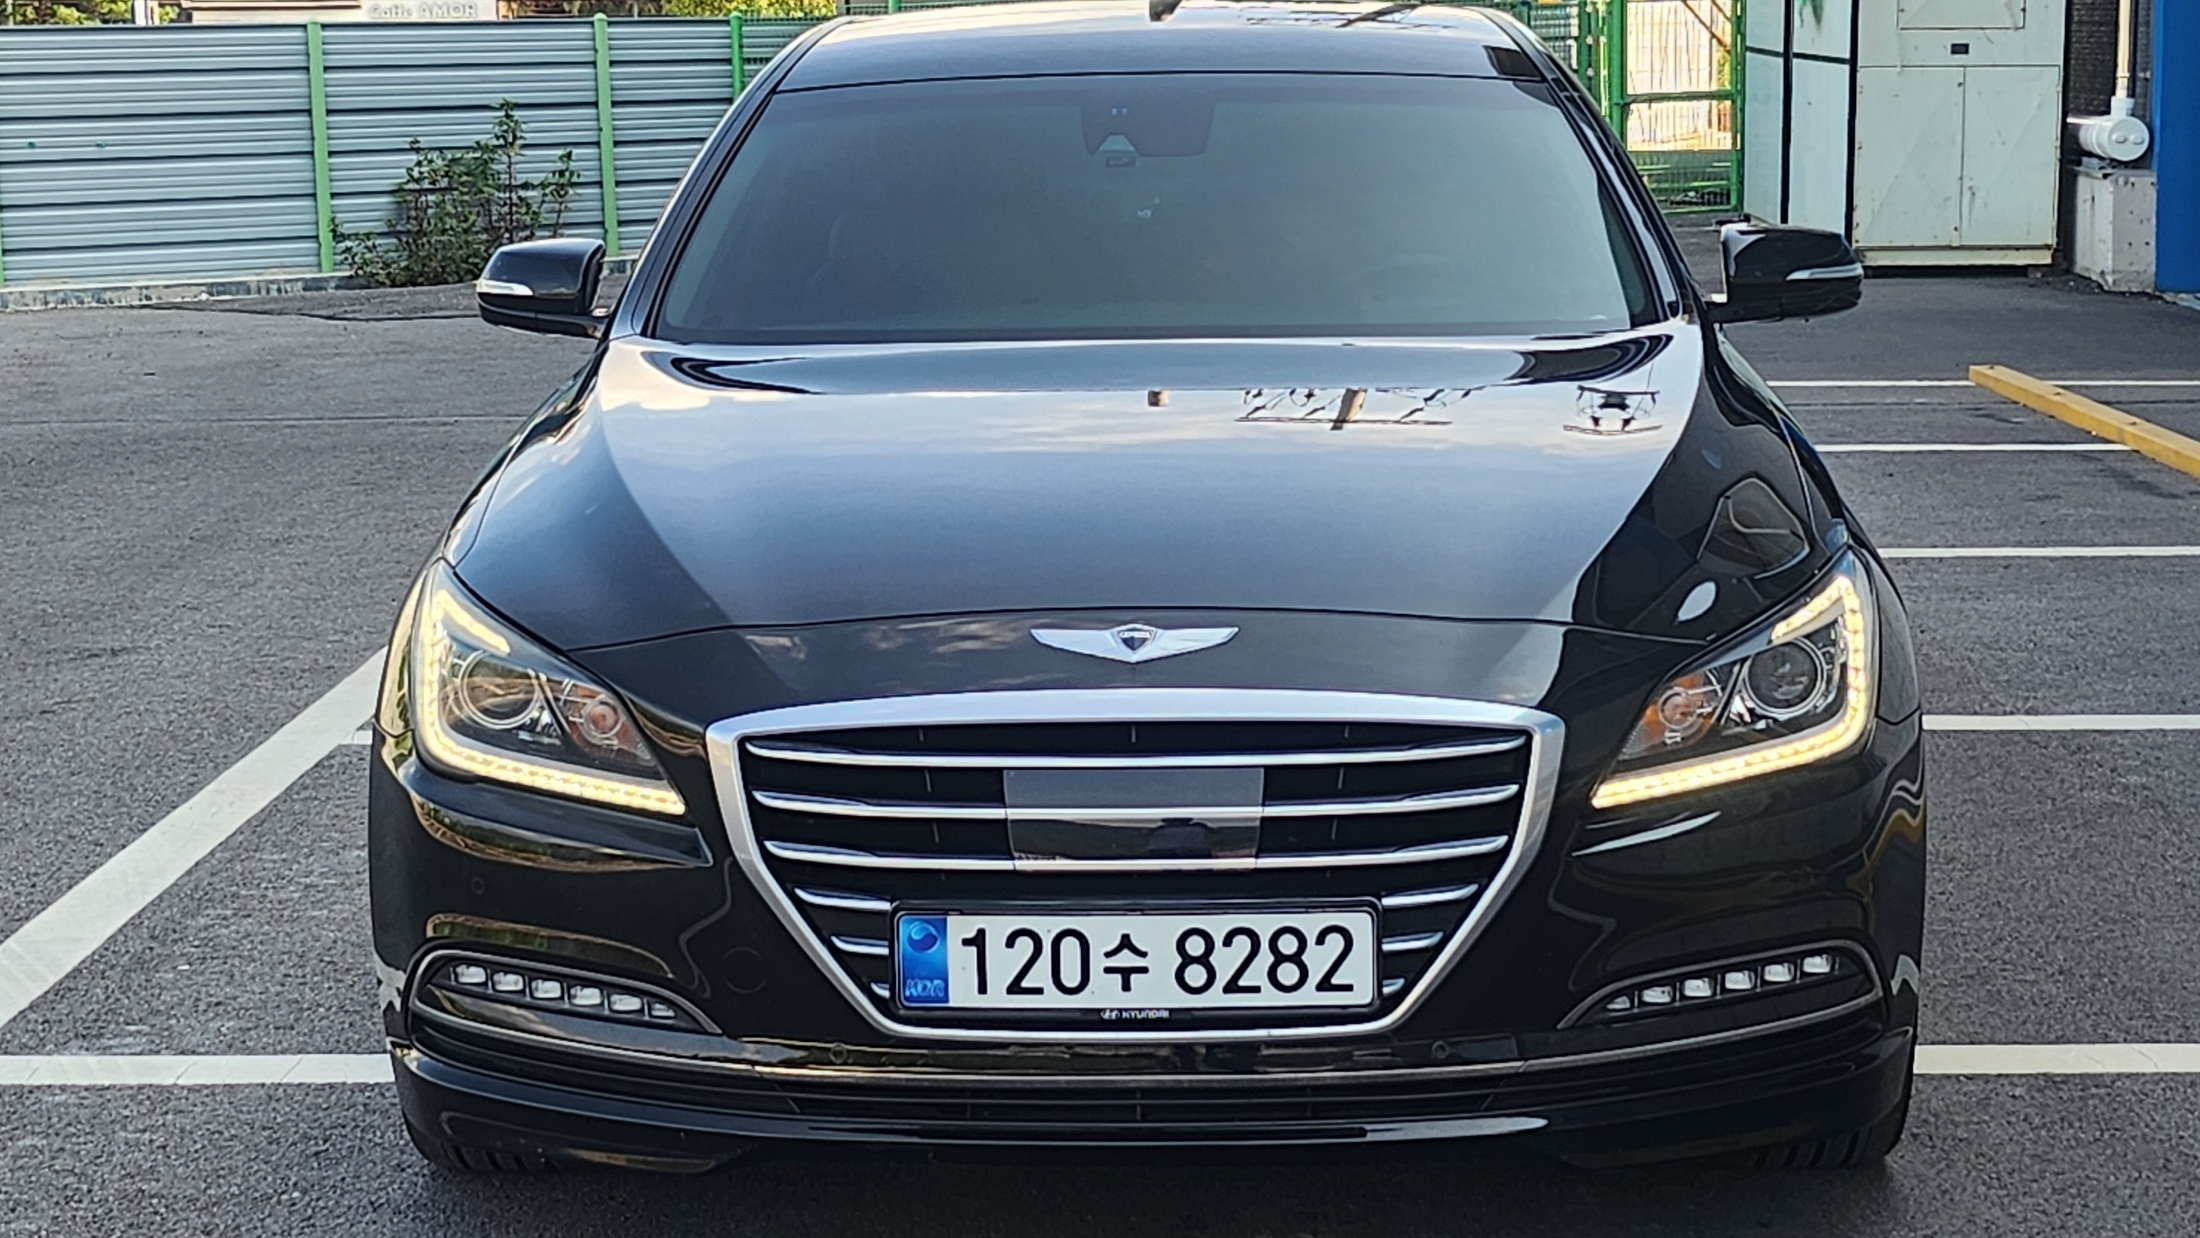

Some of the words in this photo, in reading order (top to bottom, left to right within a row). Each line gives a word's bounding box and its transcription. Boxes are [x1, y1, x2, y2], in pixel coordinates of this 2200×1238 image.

[417, 2, 478, 19] AMOR
[960, 926, 1150, 996] 120수
[1174, 924, 1355, 995] 8282
[904, 979, 946, 997] KOR
[1121, 1009, 1170, 1020] HYUNDAI
